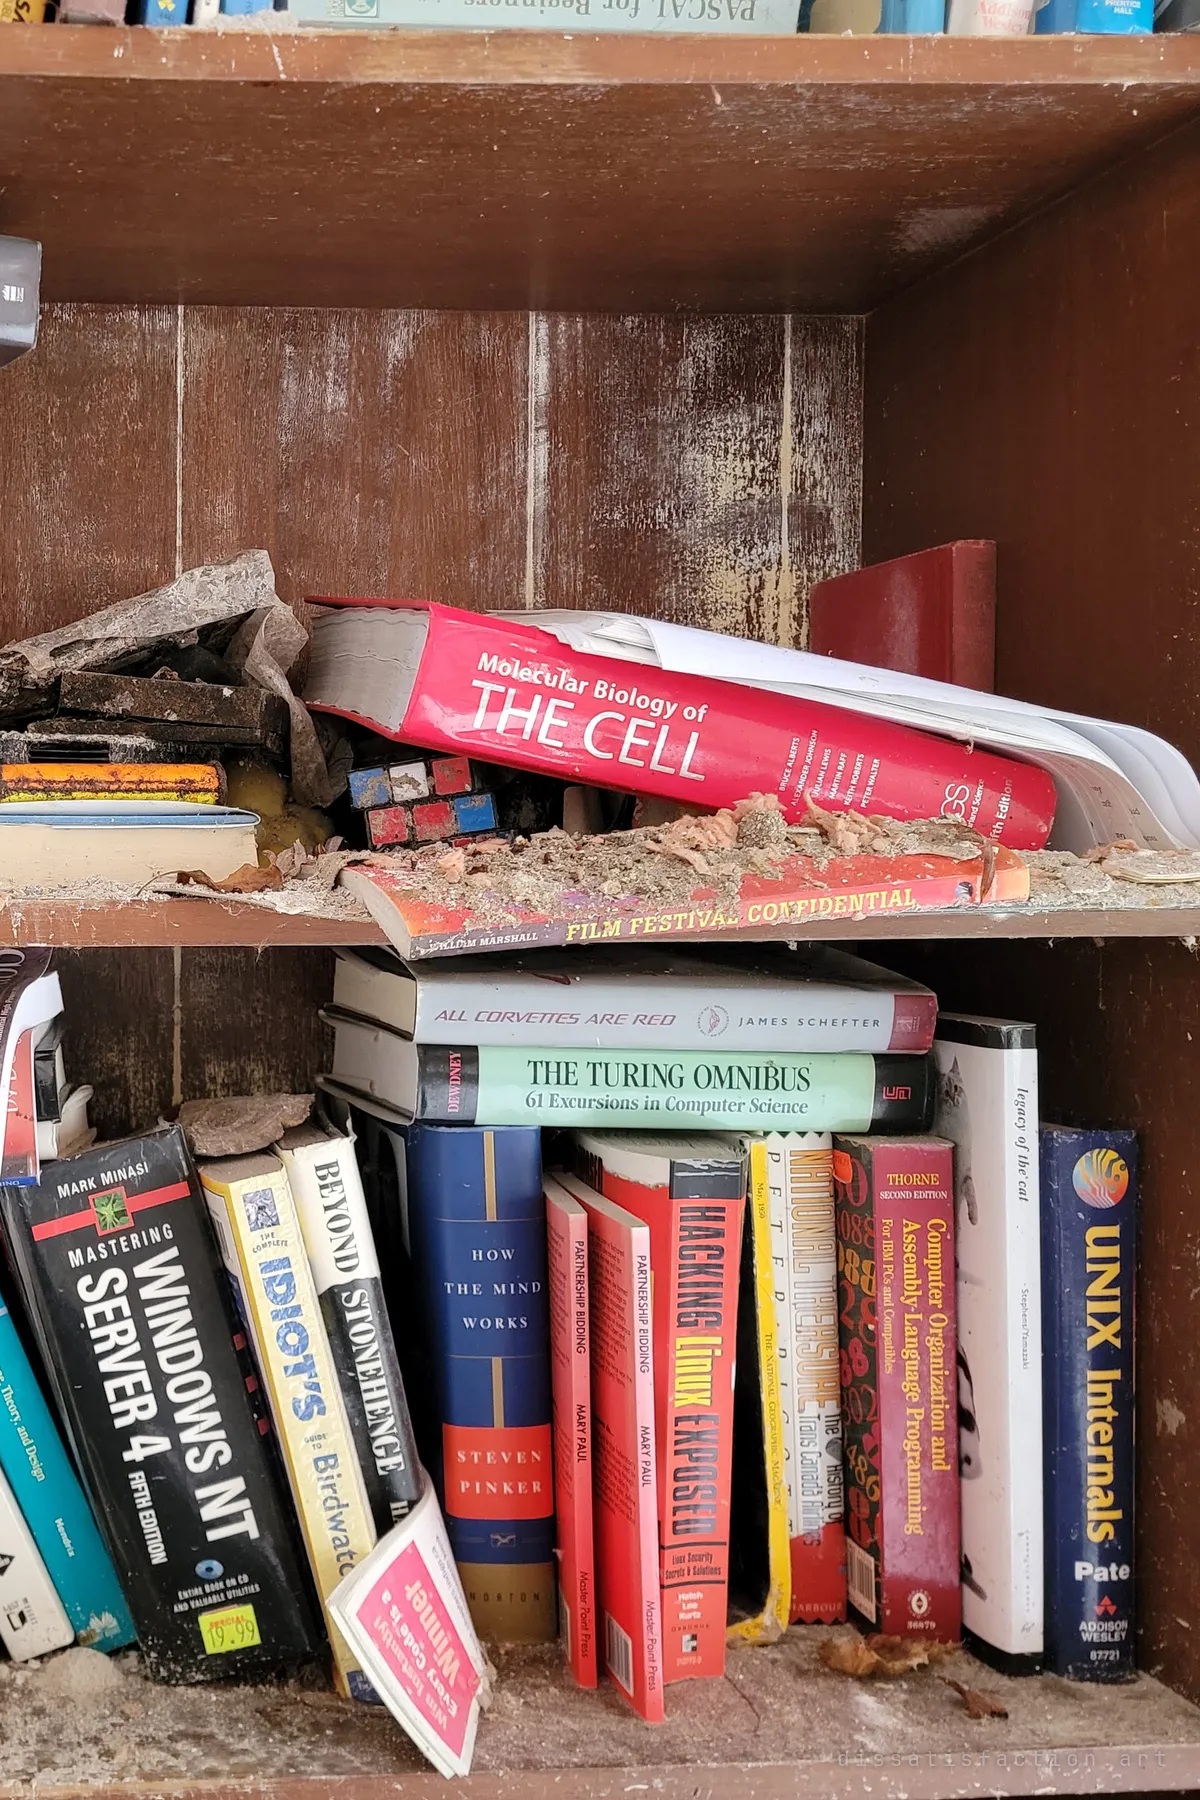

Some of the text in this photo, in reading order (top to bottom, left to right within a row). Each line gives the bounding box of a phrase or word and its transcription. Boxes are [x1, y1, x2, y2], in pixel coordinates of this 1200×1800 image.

[1114, 7, 1133, 15] HALL
[477, 652, 708, 723] Molecular Biology of
[470, 679, 705, 781] THE CELL
[434, 1009, 468, 1025] ALL
[473, 1010, 581, 1026] CORVETTES
[584, 1012, 628, 1027] ARE
[633, 1013, 677, 1027] RED
[447, 1051, 462, 1114] DEWDNEY
[527, 1059, 811, 1093] THE TURING OMNIBUS
[525, 1093, 809, 1116] 61 Excursions in Computer Science
[1014, 1087, 1029, 1202] legacy of the cat
[57, 1162, 149, 1199] MARK MINASI
[880, 1191, 947, 1200] SECOND EDITION
[887, 1174, 939, 1185] THORNE
[68, 1223, 174, 1269] MASTERING
[260, 1231, 276, 1240] THE
[444, 1281, 541, 1296] THE MIND
[882, 1218, 895, 1375] For IBM PCs and Compatibles
[314, 1158, 407, 1477] BEYOND STONEHENGE
[462, 1316, 529, 1330] WORKS
[637, 1255, 649, 1374] PARTNERSHIP BIDDING
[672, 1206, 726, 1536] HACKING Linux EXPOSED
[901, 1218, 927, 1535] Assembly Language Programming
[1086, 1224, 1123, 1544] UNIX Internals
[132, 1246, 262, 1543] WINDOWS NT
[577, 1403, 588, 1464] MARY PAUL
[641, 1425, 653, 1488] MARY PAUL
[580, 1571, 588, 1603] Master
[1074, 1560, 1130, 1582] Pate
[469, 1591, 541, 1601] NORTON
[207, 1620, 255, 1648] 19.99
[580, 1604, 588, 1634] Point
[1079, 1620, 1128, 1631] ADDISON
[646, 1600, 656, 1691] Master Point Press
[1082, 1631, 1126, 1642] WESLEY
[1090, 1650, 1120, 1661] 87721
